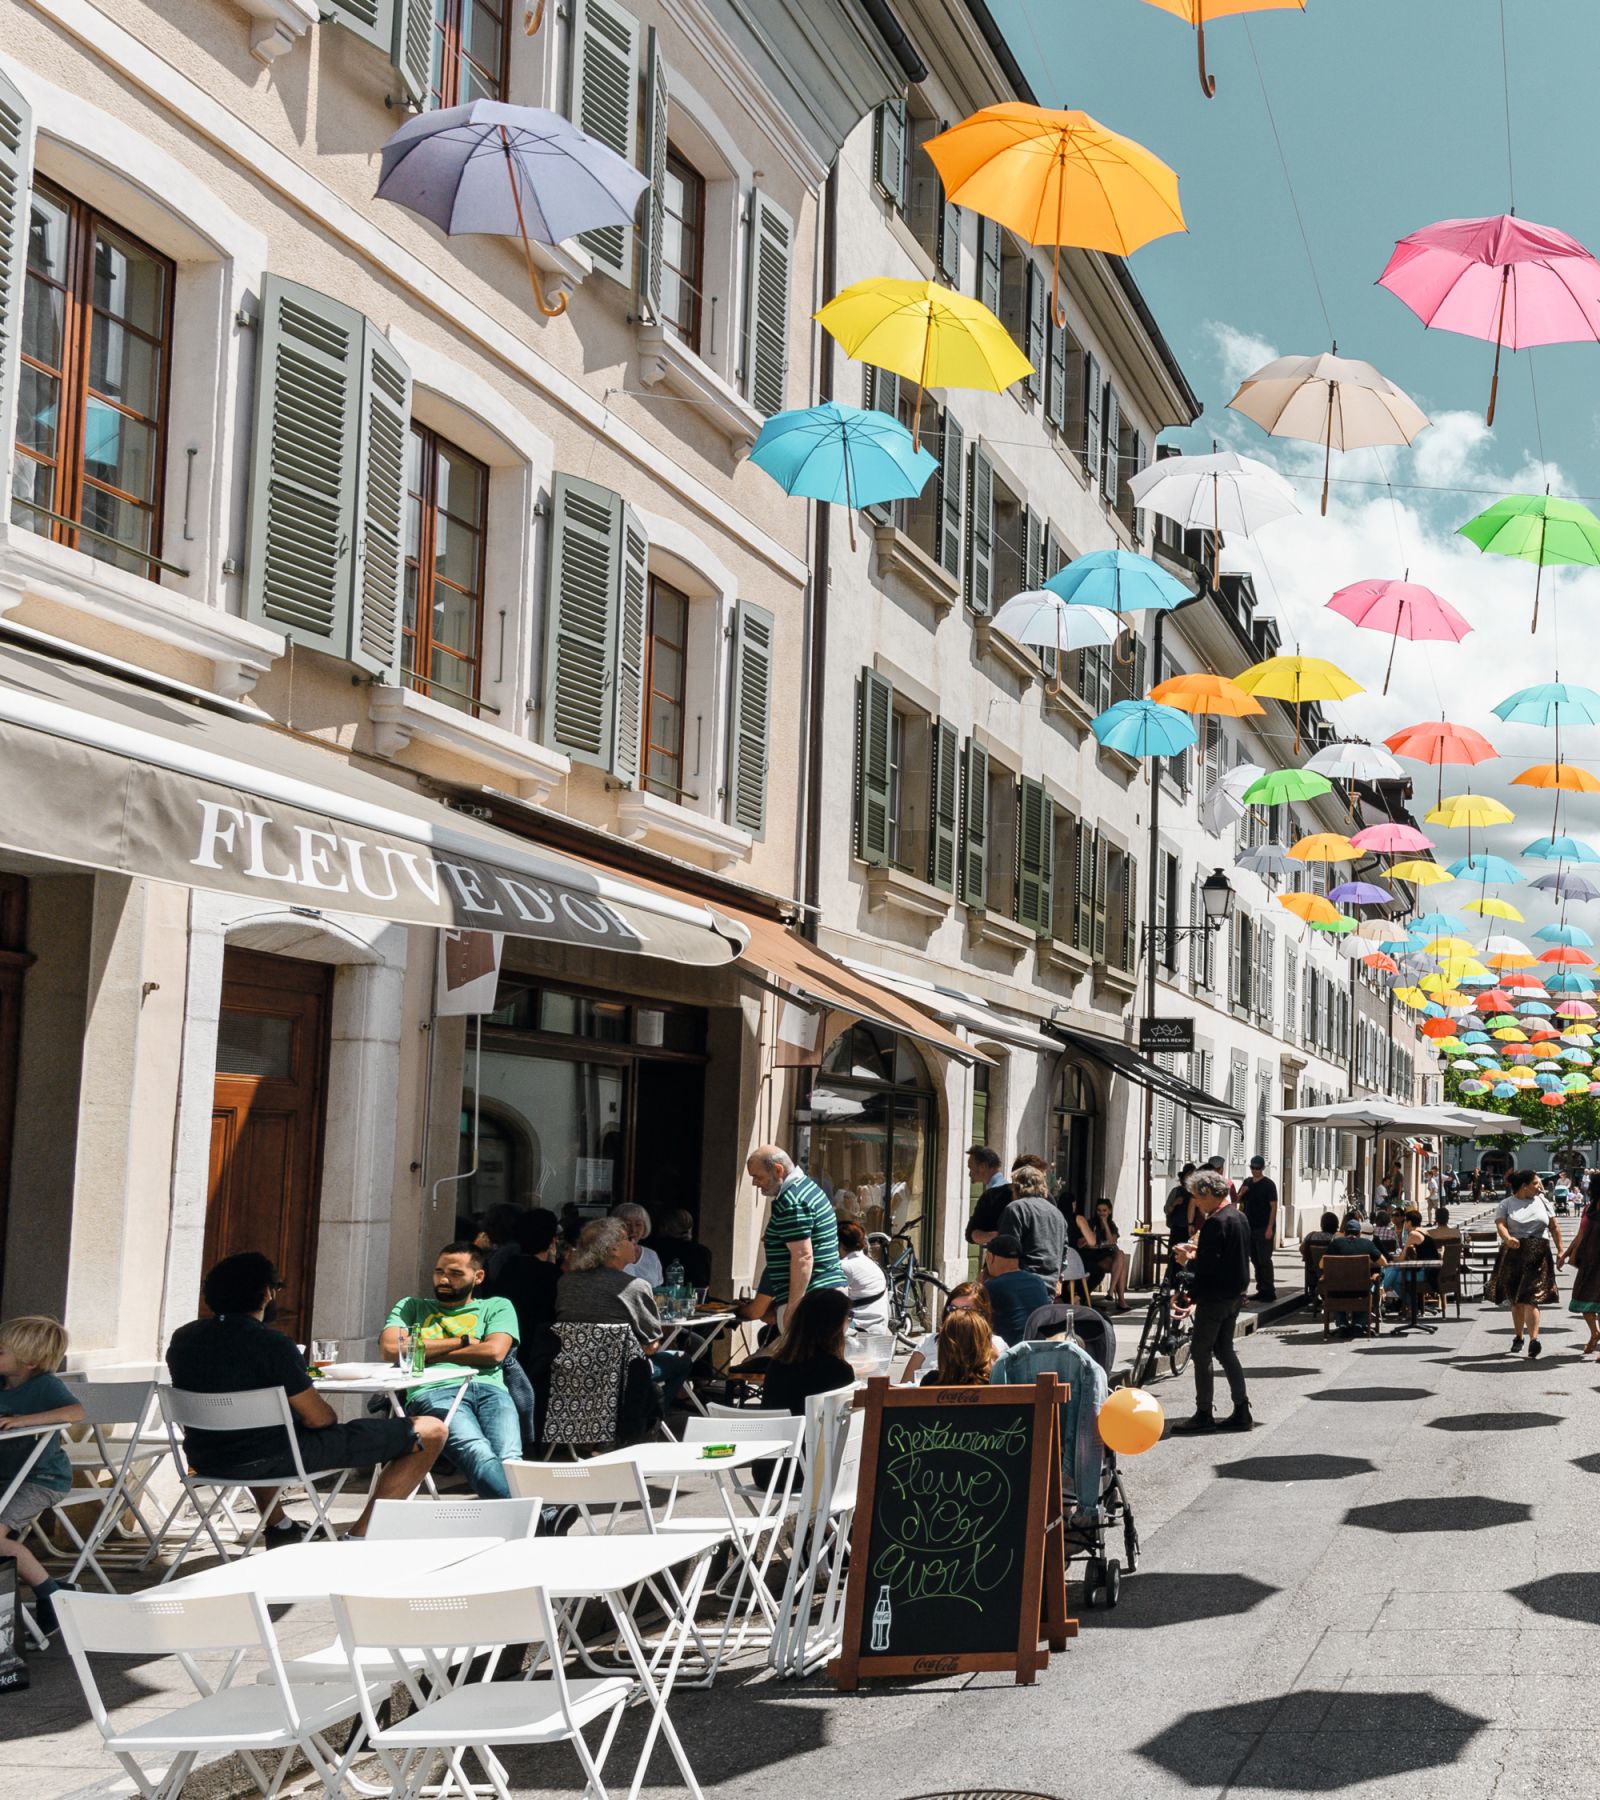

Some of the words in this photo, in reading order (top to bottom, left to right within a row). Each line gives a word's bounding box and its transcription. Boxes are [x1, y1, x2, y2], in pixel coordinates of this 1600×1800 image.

[190, 799, 504, 917] FLEUVE
[495, 876, 650, 941] D'OR
[888, 1417, 1026, 1457] Restaurant
[886, 1457, 1001, 1506] Fleuve
[0, 1672, 18, 1685] ket
